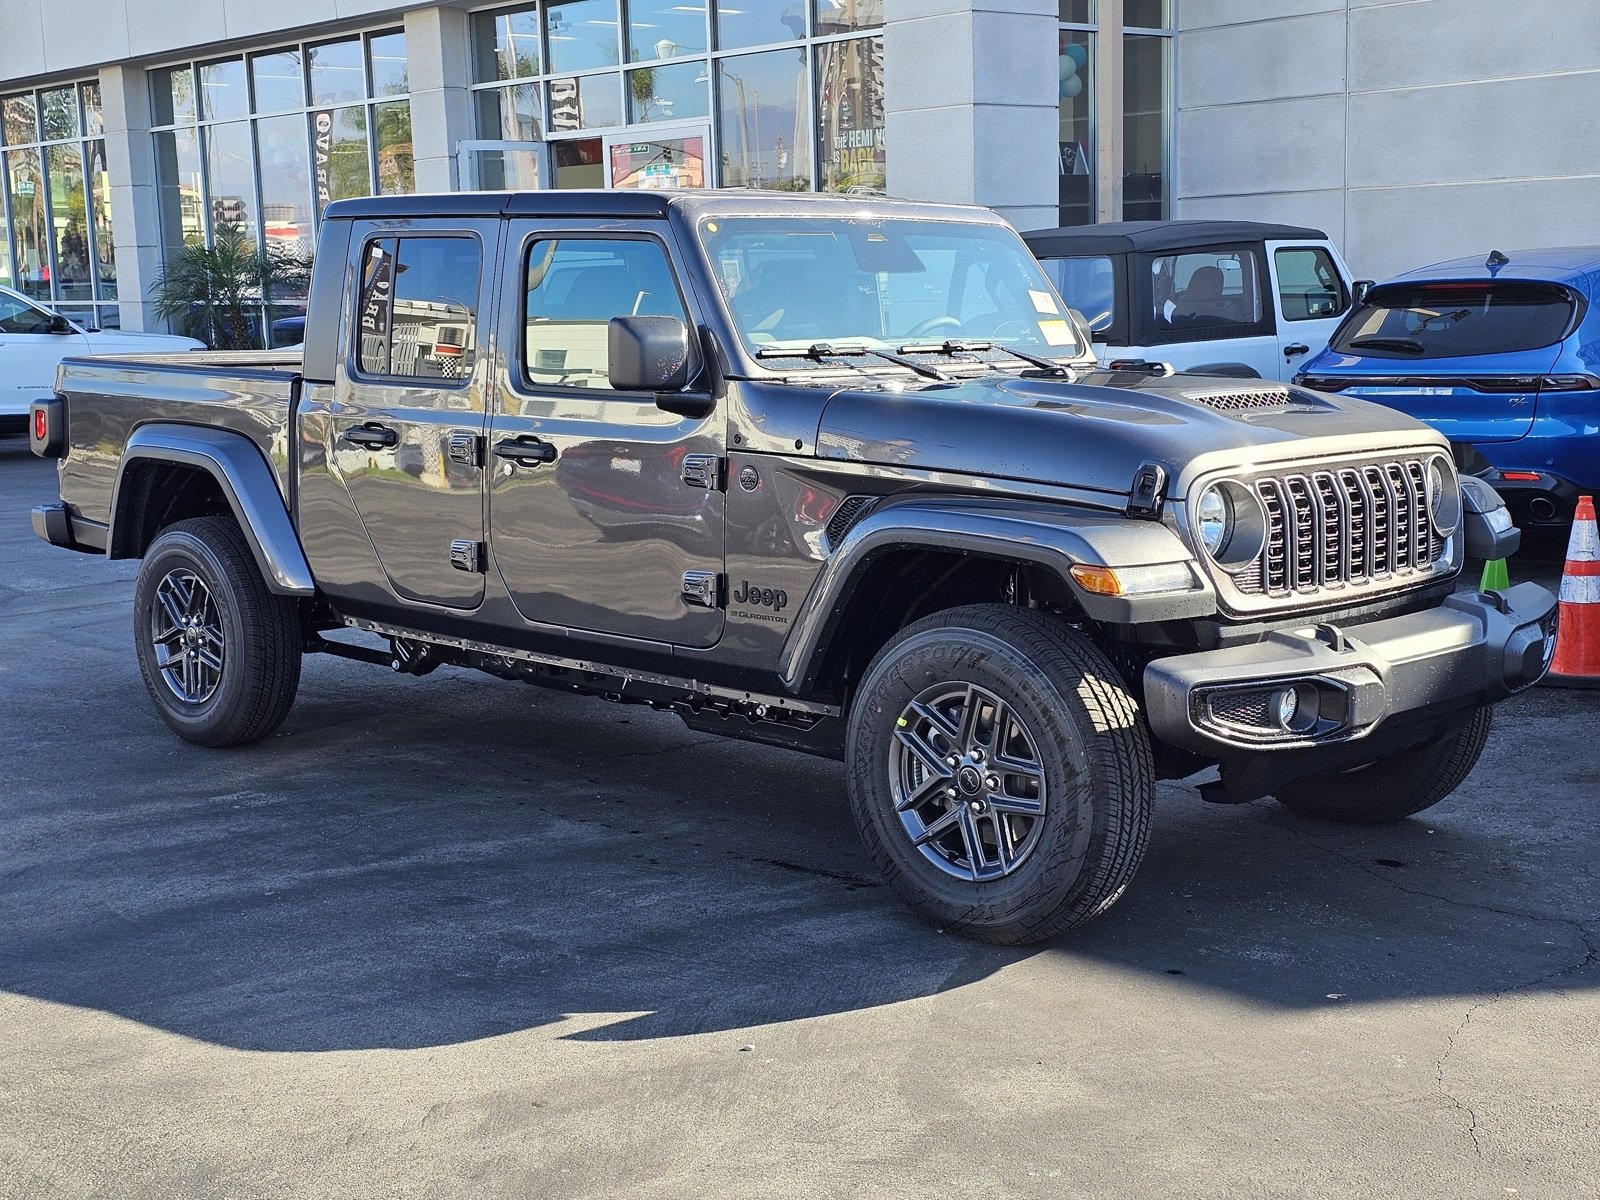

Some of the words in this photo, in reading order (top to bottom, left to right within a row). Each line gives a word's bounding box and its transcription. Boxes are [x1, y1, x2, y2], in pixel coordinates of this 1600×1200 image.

[833, 136, 847, 149] THE
[848, 129, 873, 148] HEMI
[833, 150, 840, 163] IS
[840, 147, 875, 173] BACK
[734, 581, 787, 611] Jeep
[739, 611, 788, 623] GLADIATOR
